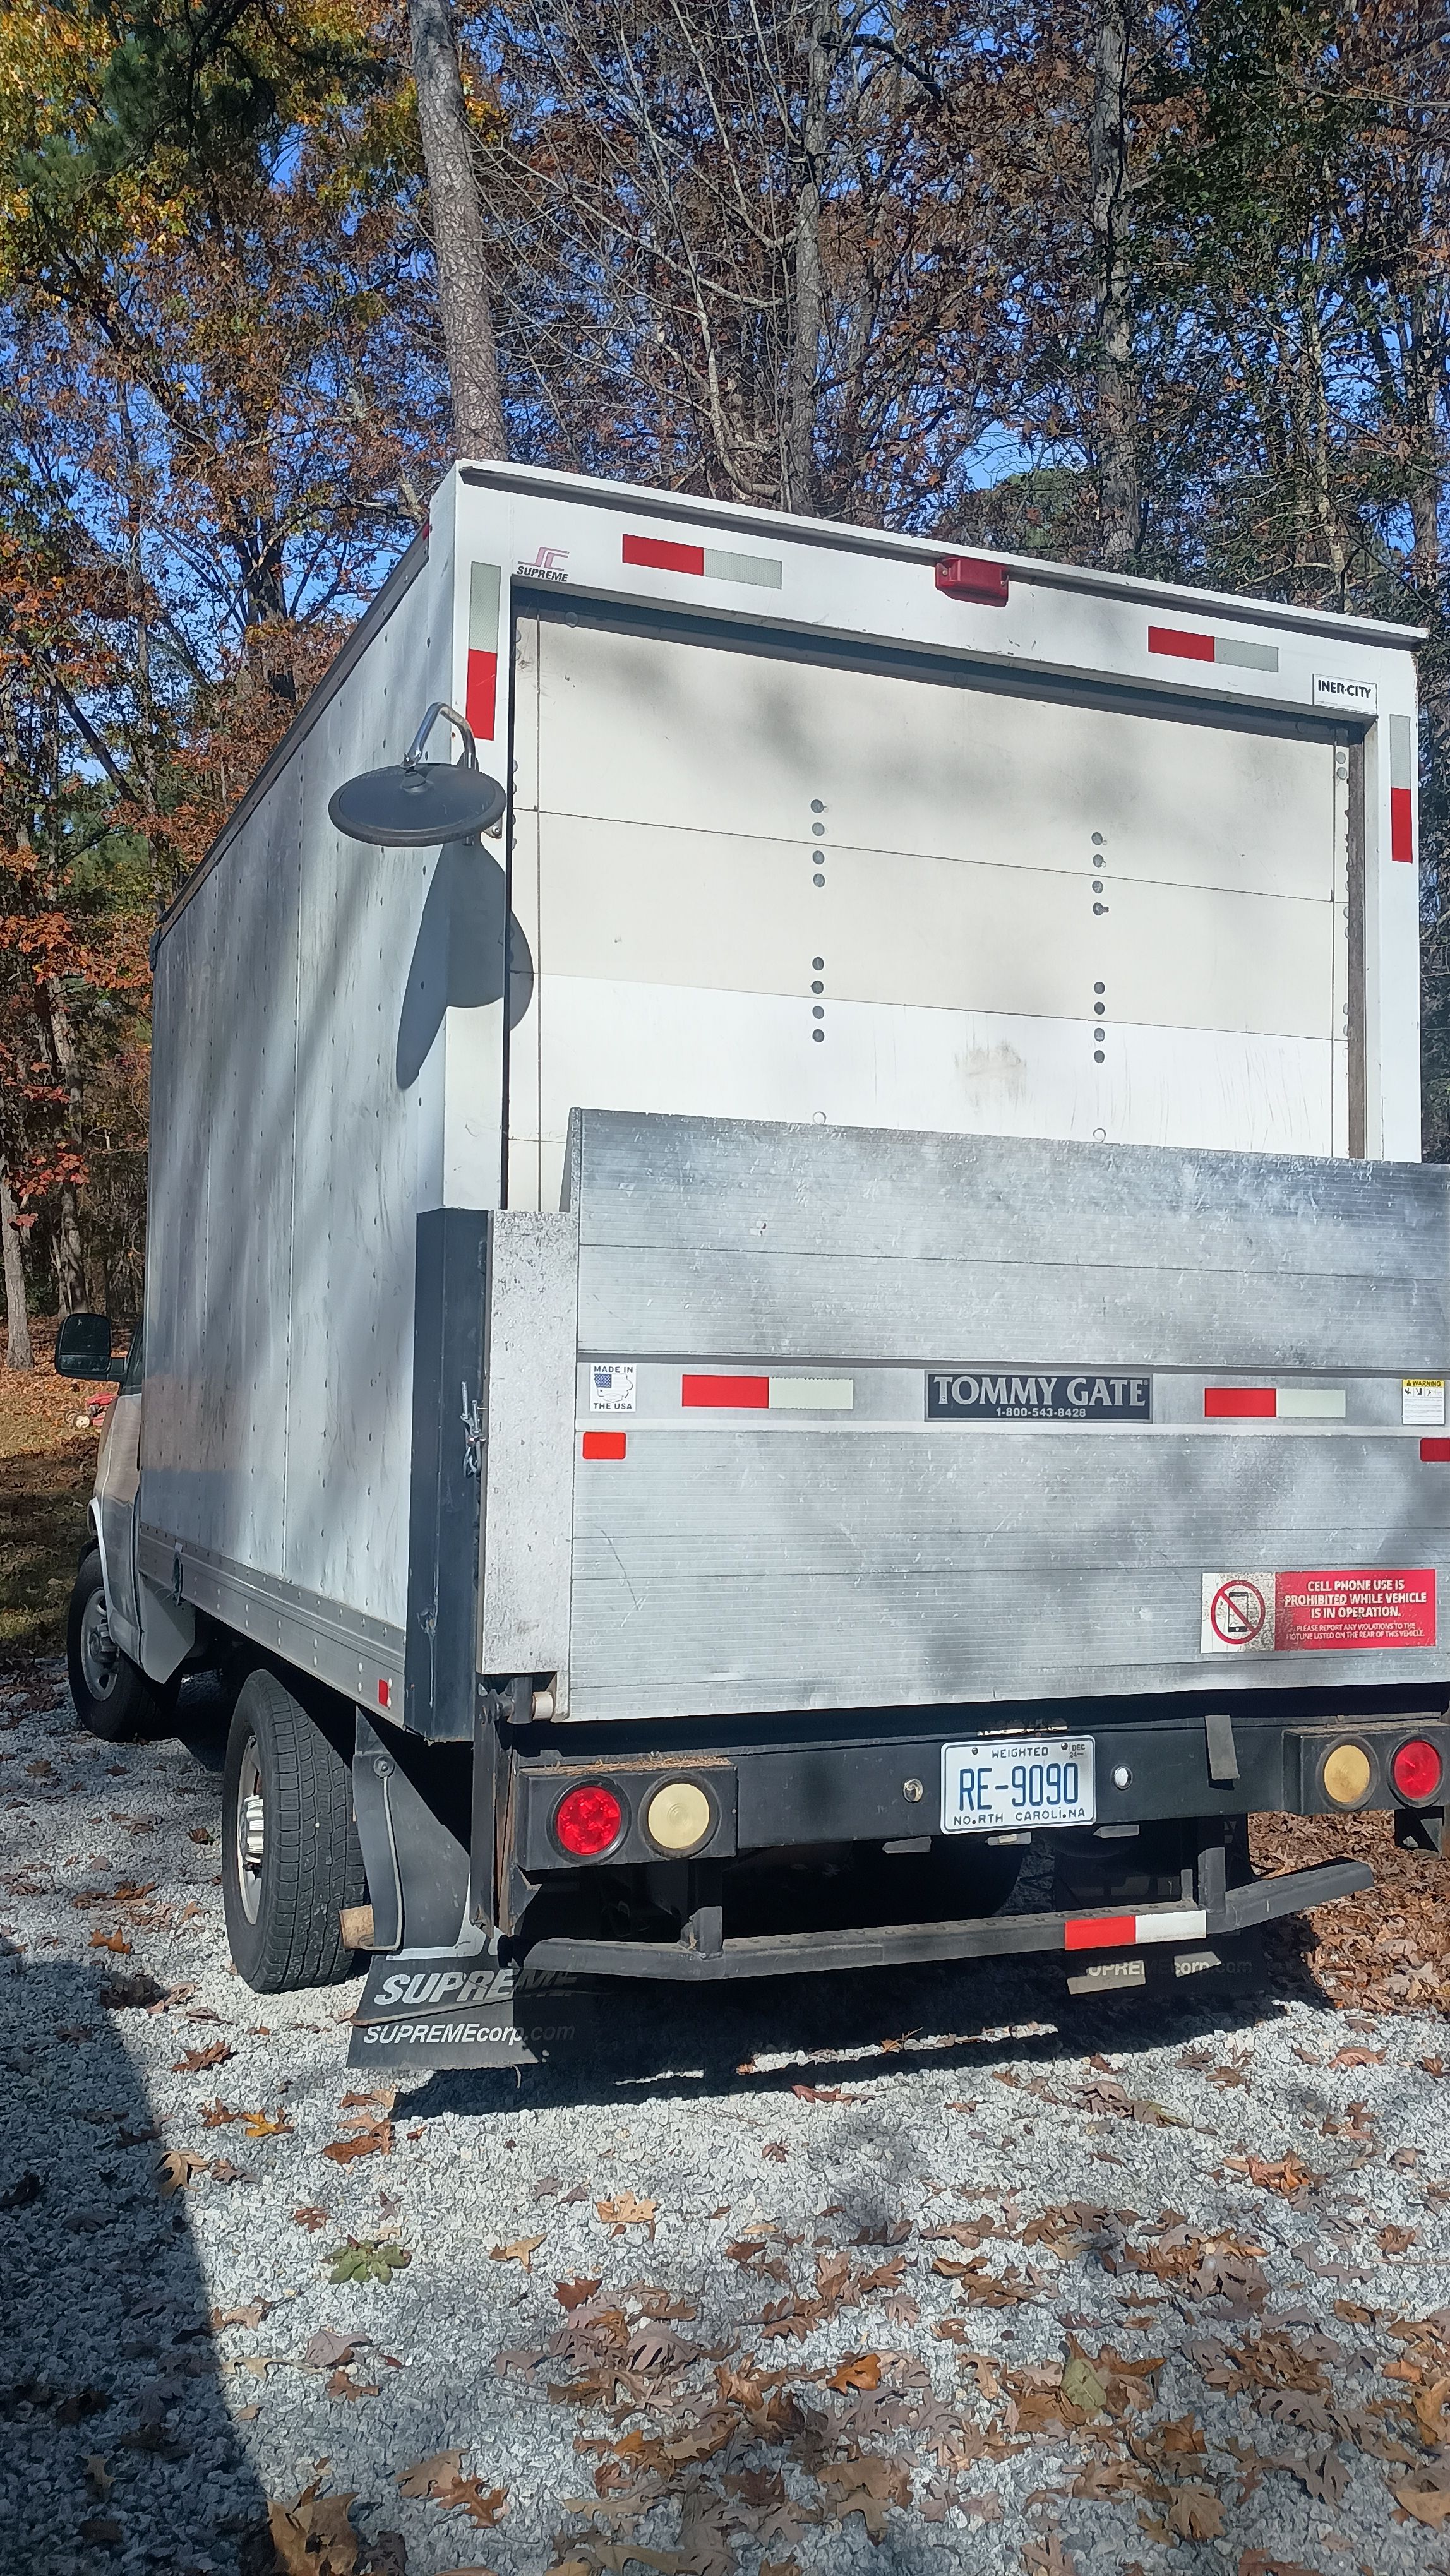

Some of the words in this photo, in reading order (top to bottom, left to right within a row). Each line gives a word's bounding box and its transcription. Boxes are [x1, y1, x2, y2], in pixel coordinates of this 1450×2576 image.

[517, 566, 568, 581] SUPREME
[933, 1376, 1057, 1405] TOMMY
[996, 1407, 1086, 1417] 1-800-543-8428
[1307, 1580, 1333, 1592] CELL
[1334, 1580, 1371, 1591] PHONE
[1373, 1580, 1393, 1590] USE
[1394, 1579, 1405, 1590] IS
[1285, 1594, 1348, 1606] PROHIBITED
[1349, 1593, 1384, 1604] WHILE
[1385, 1592, 1427, 1603] VEHICLE
[1311, 1607, 1321, 1619] IS
[1323, 1607, 1336, 1618] IN
[1338, 1606, 1401, 1618] OPERATION.
[1286, 1632, 1313, 1640] HOTLINE
[1314, 1631, 1334, 1640] LISTED
[992, 1746, 1049, 1758] WEIGHTED
[1072, 1743, 1086, 1751] DEC
[959, 1762, 1079, 1811] RE-9090
[954, 1813, 1004, 1826] NORTH
[1015, 1808, 1086, 1822] CAROLINA
[362, 2022, 576, 2046] SUPREMEcorp.com
